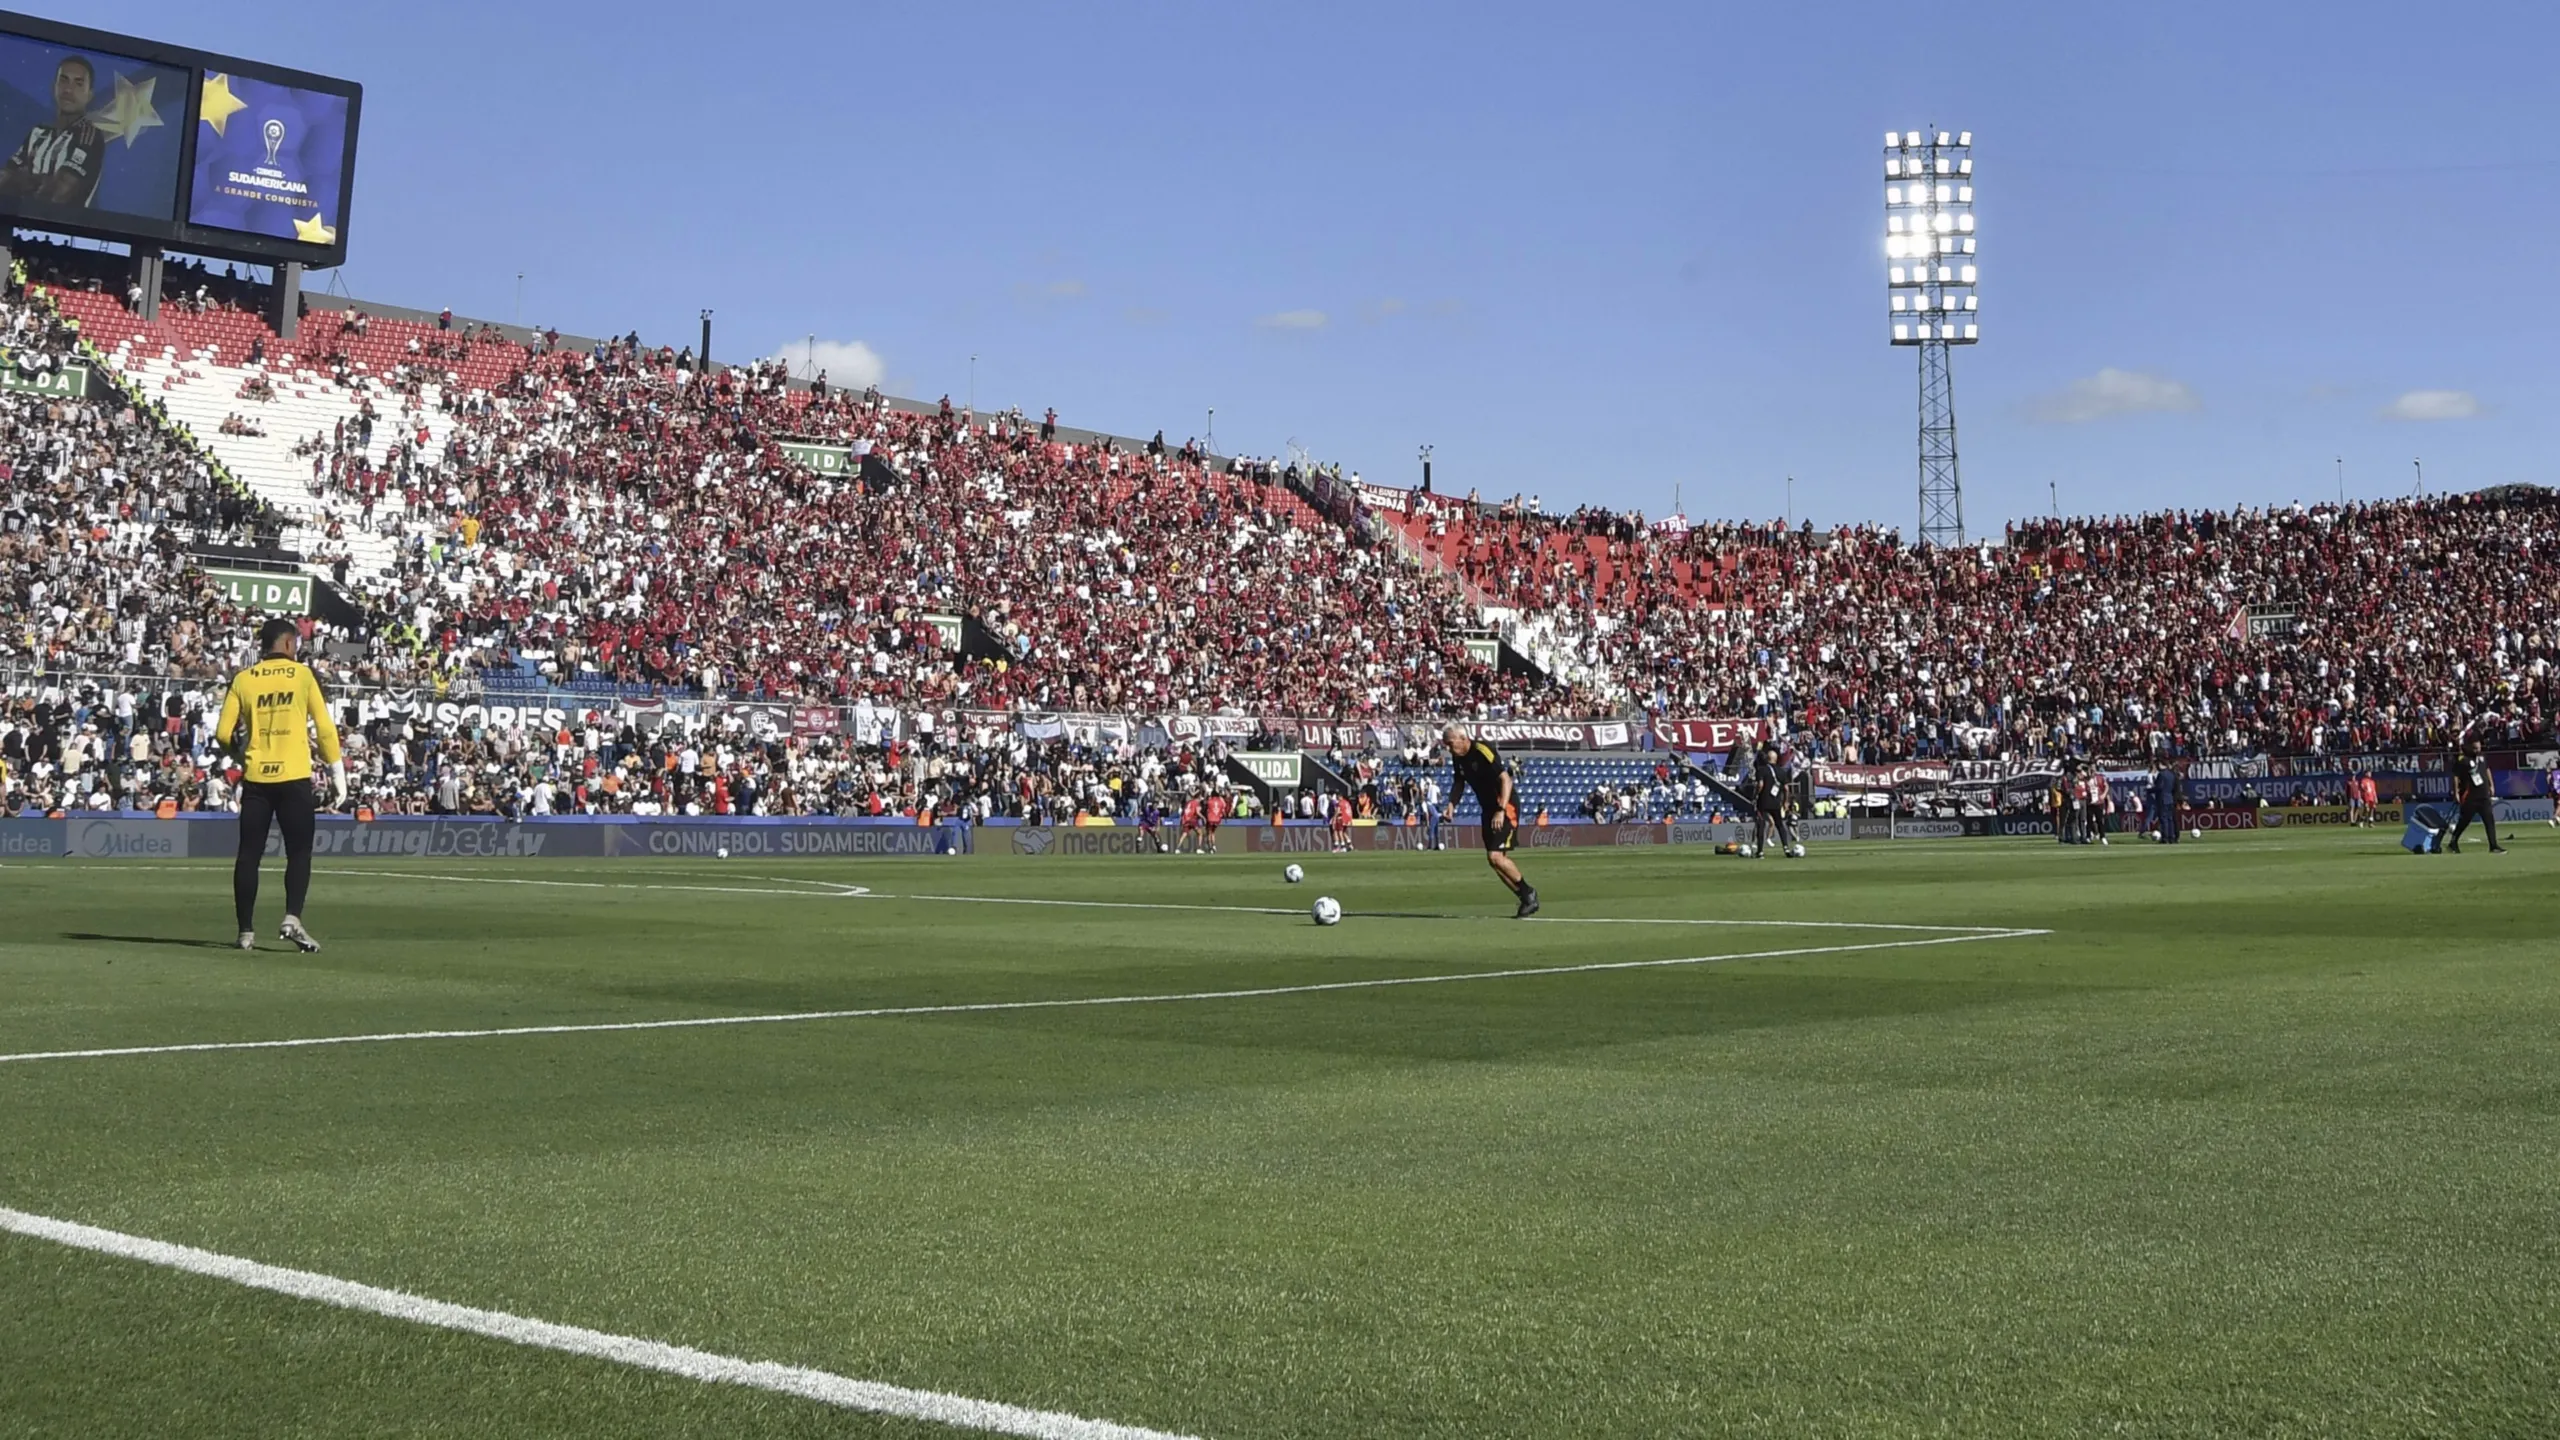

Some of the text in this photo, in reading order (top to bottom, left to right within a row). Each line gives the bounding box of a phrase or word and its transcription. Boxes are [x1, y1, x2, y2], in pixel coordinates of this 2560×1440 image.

[228, 171, 308, 194] SUDAMERICANA
[224, 186, 261, 199] GRANDE
[265, 193, 318, 208] CONQUISTA
[262, 667, 296, 679] bmg
[1303, 725, 1320, 745] LA
[1322, 725, 1362, 746] NRTE
[1481, 725, 1584, 742] CENTENARIO
[262, 764, 280, 774] BH
[2181, 811, 2254, 830] MOTOR
[2505, 807, 2550, 822] Midea
[1683, 825, 1713, 841] world
[1812, 821, 1845, 836] world
[1858, 823, 1960, 835] BASTA DE RACISMO
[2004, 821, 2054, 835] ueno
[99, 832, 172, 853] Midea
[649, 831, 934, 853] CONMEBOL SUDAMERICANA
